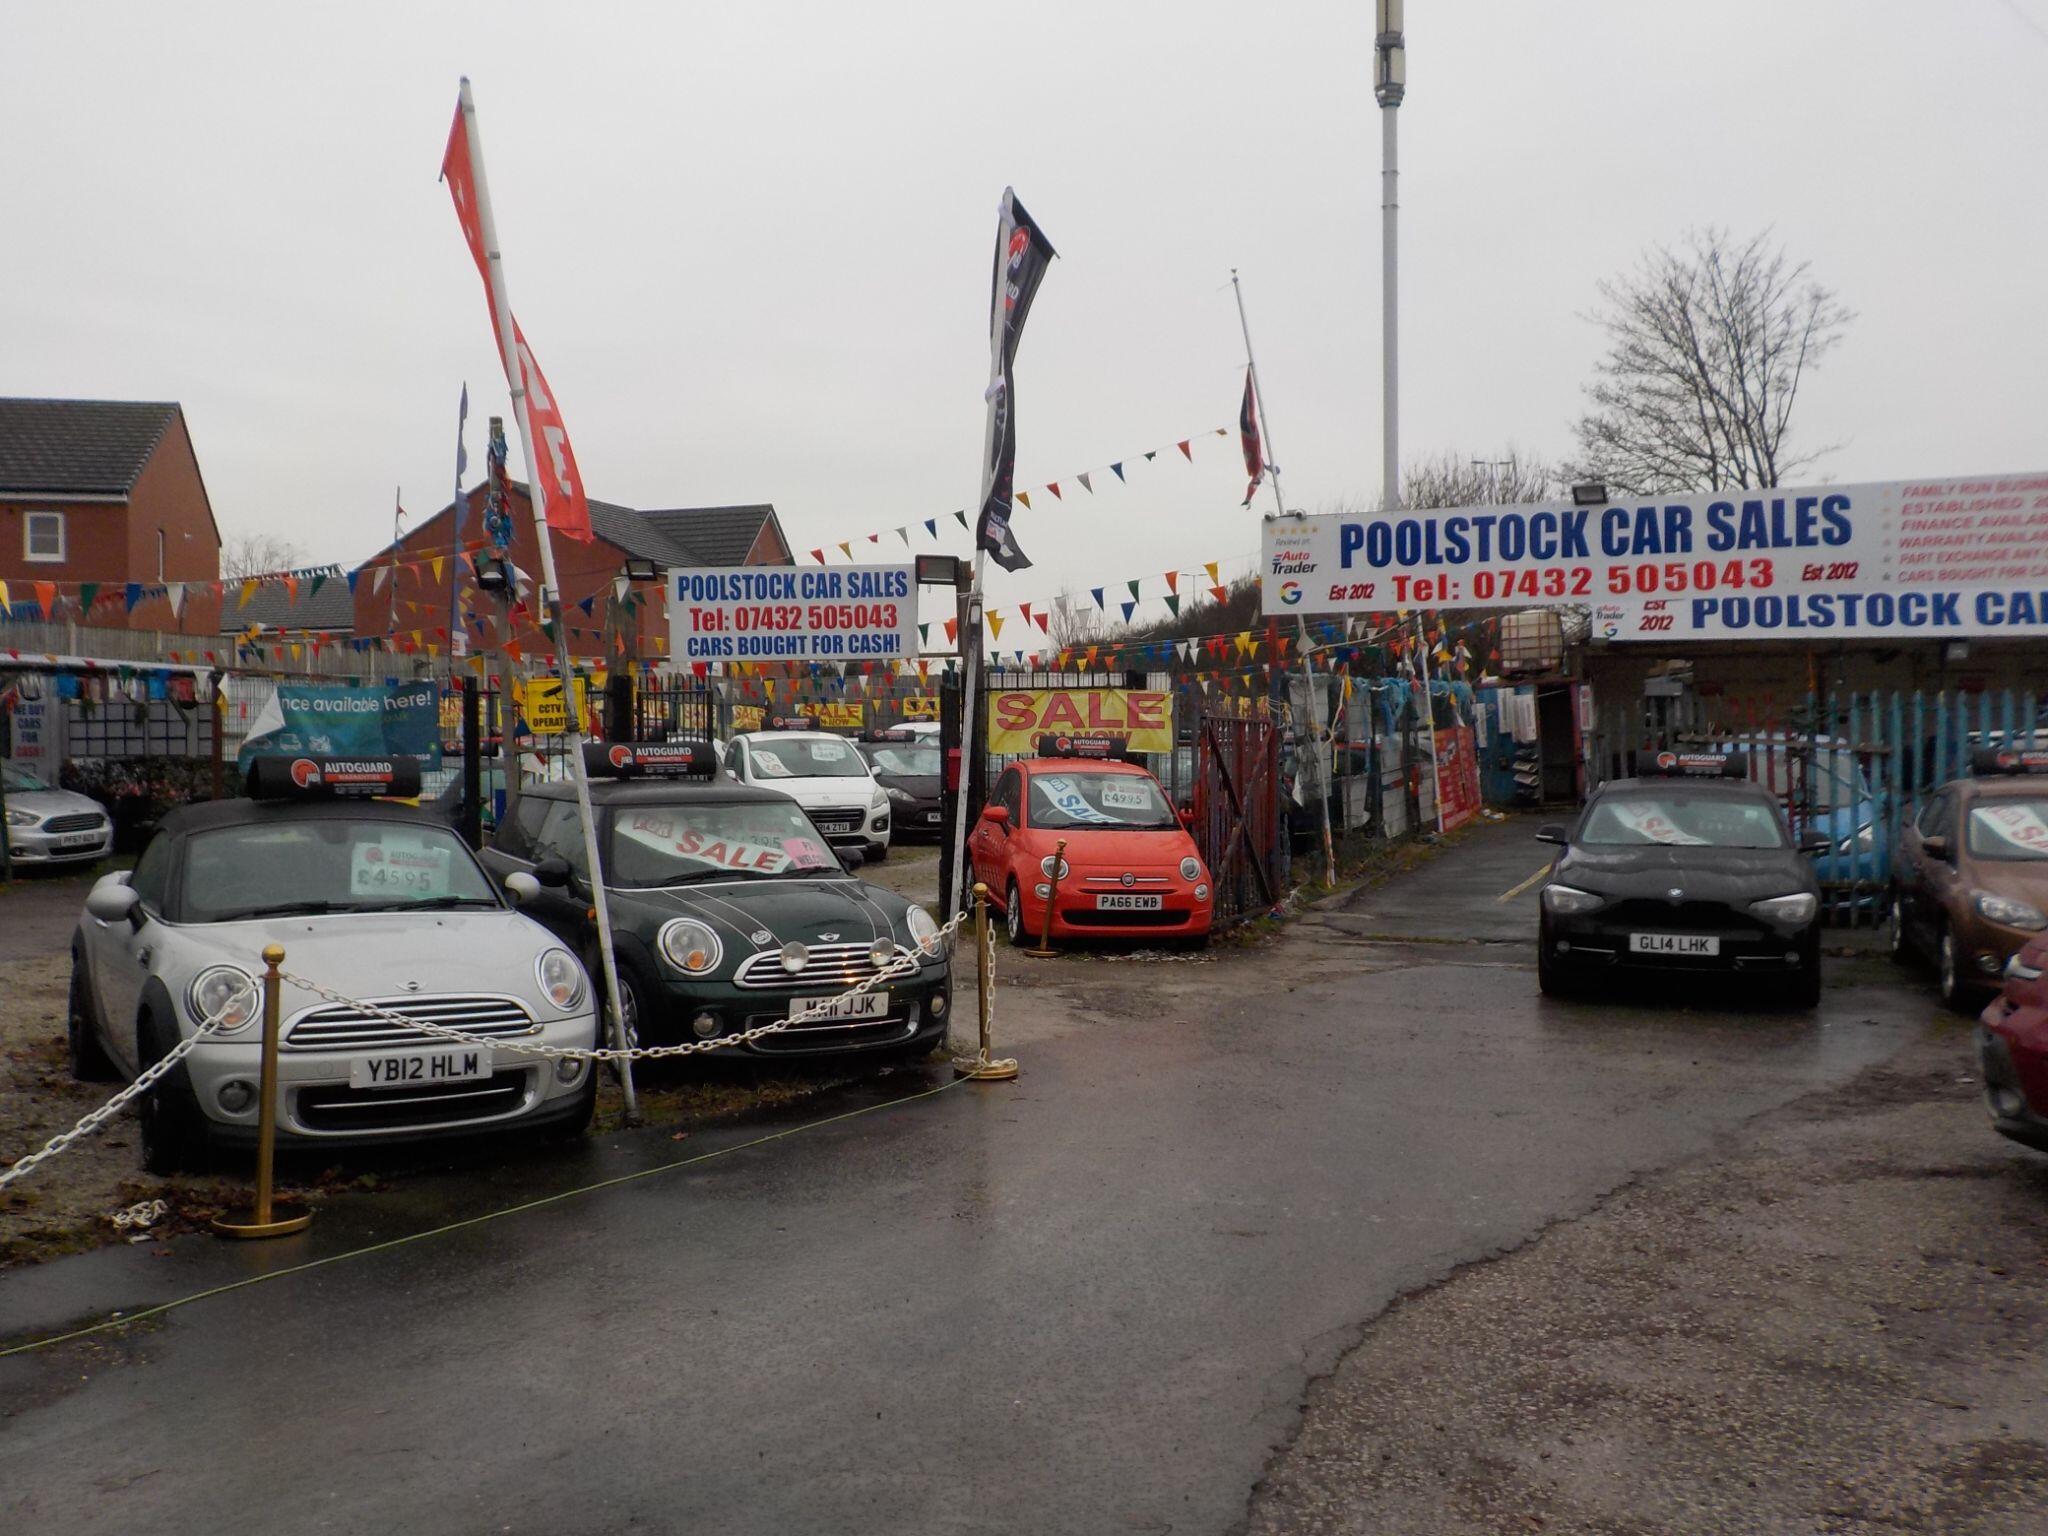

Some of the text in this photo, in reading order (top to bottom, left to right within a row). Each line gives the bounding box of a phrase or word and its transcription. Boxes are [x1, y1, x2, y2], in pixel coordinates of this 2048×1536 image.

[1902, 483, 1956, 498] FAMILY
[1901, 496, 2024, 516] ESTABLISHED
[1340, 493, 1853, 569] POOLSTOCK CAR SALES
[1901, 514, 1974, 531] FINANCE
[1899, 532, 1985, 548] WARRANTY
[1283, 551, 1311, 561] Auto
[1899, 551, 1934, 565] PART
[1272, 561, 1318, 574] Trader
[1802, 561, 1859, 582] Est 2012
[1898, 568, 1935, 583] CARS
[1937, 566, 1996, 582] BOUGHT
[678, 570, 908, 602] POOLSTOCK CAR SALES
[1392, 557, 1774, 603] Tel: 07432 505043
[1329, 583, 1375, 600] Est 2012
[690, 603, 898, 632] Tel: 07432 505043
[1692, 591, 1962, 629] POOLSTOCK
[1638, 615, 1674, 631] 2012
[687, 633, 901, 657] CARS BOUGHT FOR CASH!
[313, 695, 380, 713] available
[383, 690, 432, 711] here!
[538, 703, 563, 714] CCTV
[802, 704, 864, 718] SALE
[996, 691, 1166, 731] SALE
[1073, 738, 1111, 746] AUTOGUARD
[636, 746, 692, 756] AUTOGUARD
[1679, 753, 1727, 762] AUTOGUARD
[324, 762, 393, 773] AUTOGUARD
[675, 829, 785, 871] SALE
[357, 868, 431, 892] £4595
[1101, 897, 1158, 908] PA66 EWB
[1639, 936, 1710, 952] GL14 LHK
[843, 996, 876, 1015] JJK
[367, 1053, 478, 1082] YB12 HLM
